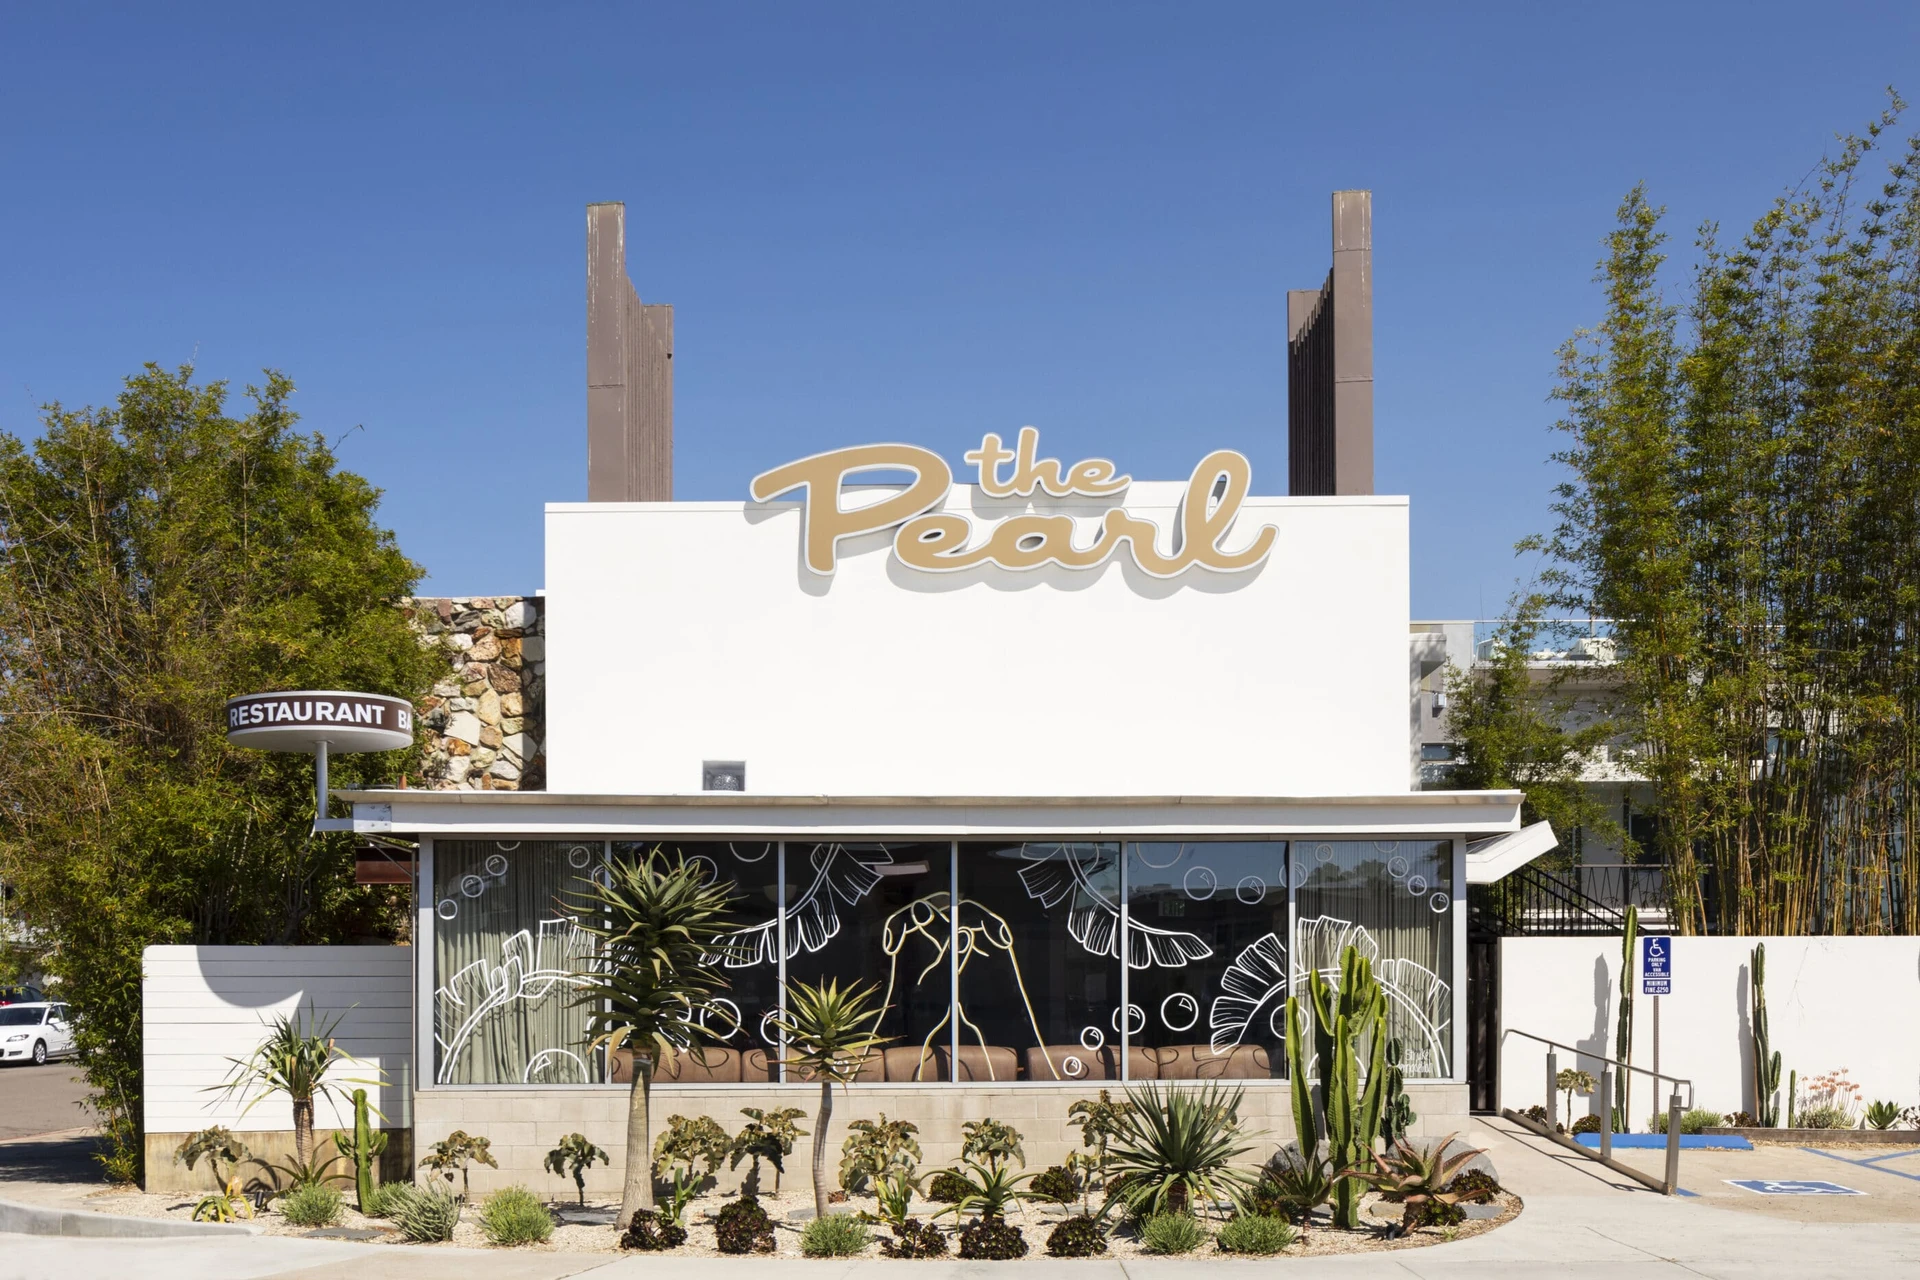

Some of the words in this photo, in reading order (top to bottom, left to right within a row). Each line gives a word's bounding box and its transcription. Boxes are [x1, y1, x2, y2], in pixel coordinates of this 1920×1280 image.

[964, 427, 1132, 497] the
[750, 443, 1279, 577] Pearl
[230, 701, 385, 727] RESTAURANT
